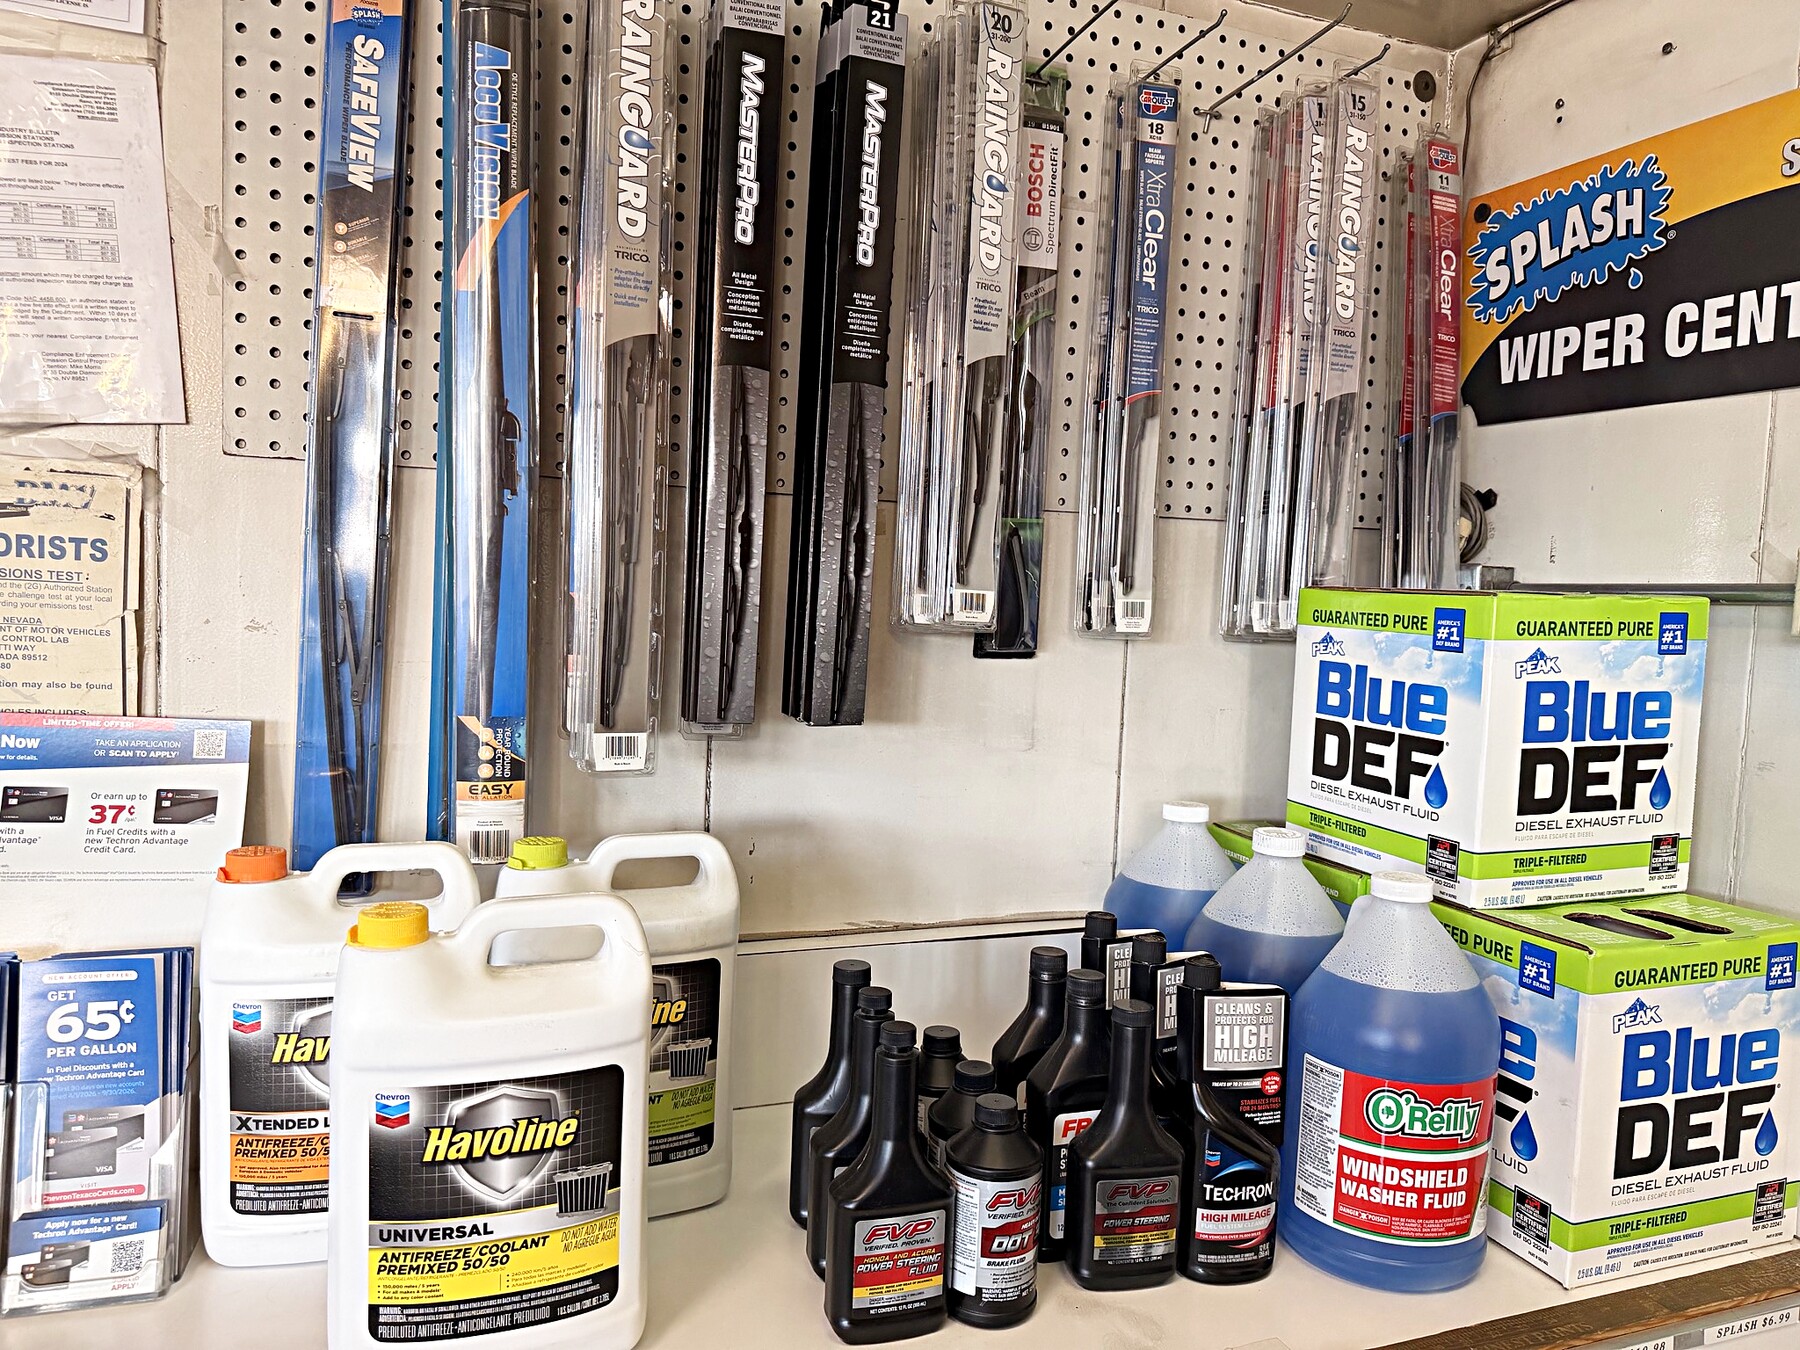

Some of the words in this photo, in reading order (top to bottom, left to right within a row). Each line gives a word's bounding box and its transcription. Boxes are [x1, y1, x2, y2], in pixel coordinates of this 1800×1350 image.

[354, 10, 381, 20] SPLASH
[870, 11, 892, 29] 21
[990, 12, 1012, 33] 20
[990, 32, 1012, 44] 31-200
[342, 42, 353, 105] PERFORMANCE
[1350, 94, 1366, 111] 15
[341, 107, 350, 134] WIPER
[348, 34, 385, 193] SAFEVIEW
[1350, 111, 1366, 121] 31-150
[1147, 122, 1165, 135] 18
[340, 136, 349, 163] BLADE
[735, 51, 766, 245] MASTERPRO
[978, 47, 1015, 271] RAINGUARD
[857, 80, 887, 267] MASTERPRO
[1027, 142, 1045, 218] BOSCH
[1049, 147, 1059, 197] DirectFit
[1438, 174, 1450, 185] 11
[1045, 200, 1055, 254] Spectrum
[1334, 125, 1368, 320] RAINGUARD
[1485, 188, 1644, 301] SPLASH
[614, 250, 650, 263] TRICO
[734, 278, 754, 286] Design
[976, 281, 1002, 293] TRICO
[728, 292, 760, 300] Conception
[1023, 284, 1046, 302] Beam
[849, 311, 878, 320] Conception
[1136, 305, 1159, 315] TRICO
[721, 327, 764, 336] completamente
[1333, 328, 1356, 338] TRICO
[1437, 333, 1456, 342] TRICO
[1499, 313, 1646, 384] WIPER
[44, 584, 84, 592] Authorized
[1313, 609, 1389, 628] GUARANTEED
[1393, 615, 1428, 631] PURE
[1517, 621, 1613, 637] GUARANTEED
[1617, 620, 1653, 636] PURE
[2, 635, 48, 643] CONTROL
[67, 628, 111, 637] VEHICLES
[1437, 626, 1460, 641] #1
[22, 681, 42, 689] may
[86, 682, 113, 690] found
[1316, 660, 1448, 735] Blue
[1523, 680, 1672, 743] Blue
[43, 718, 102, 727] LIMITED-TIME
[1, 734, 40, 749] Now
[95, 739, 116, 747] TAKE
[117, 739, 129, 747] AN
[130, 740, 181, 748] APPLICATION
[504, 727, 512, 749] YEAR
[495, 728, 503, 777] PROTECTION
[1312, 718, 1445, 800] DEF
[504, 750, 512, 778] ROUND
[469, 783, 514, 795] EASY
[1517, 743, 1669, 816] DEF
[1311, 780, 1346, 797] DIESEL
[1348, 790, 1401, 812] EXHAUST
[1403, 804, 1439, 822] FLUID
[88, 805, 135, 824] 37¢
[1515, 820, 1562, 832] DIESEL
[1566, 816, 1626, 829] EXHAUST
[1628, 813, 1663, 825] FLUID
[1310, 812, 1366, 838] TRIPLE-FILTERED
[143, 837, 189, 846] Advantage
[1514, 854, 1586, 869] TRIPLE-FILTERED
[1473, 936, 1514, 963] PURE
[1614, 961, 1719, 988] GUARANTEED
[1723, 956, 1761, 976] PURE
[47, 990, 76, 1001] GET
[1215, 1002, 1263, 1016] CLEANS
[1265, 1002, 1273, 1015] &
[46, 1000, 136, 1043] 65¢
[1215, 1016, 1257, 1025] PROTECTS
[1259, 1015, 1275, 1025] FOR
[1613, 1007, 1663, 1033] PEAK
[1215, 1025, 1273, 1049] HIGH
[47, 1047, 76, 1058] PER
[80, 1042, 137, 1056] GALLON
[1213, 1048, 1273, 1063] MILEAGE
[56, 1065, 71, 1073] Fuel
[73, 1063, 110, 1072] Discounts
[112, 1061, 128, 1069] with
[1620, 1028, 1780, 1102] Blue
[56, 1074, 85, 1082] Techron
[86, 1071, 126, 1081] Advantage
[127, 1069, 145, 1077] Card
[375, 1093, 410, 1101] Chevron
[235, 1116, 320, 1132] XTENDED
[1371, 1095, 1479, 1135] O'Reilly
[423, 1118, 578, 1162] Havoline
[1614, 1083, 1776, 1180] DEF
[95, 1165, 113, 1173] VISA
[1342, 1155, 1468, 1188] WINDSHIELD
[1611, 1180, 1662, 1198] DIESEL
[1666, 1170, 1729, 1190] EXHAUST
[1730, 1159, 1770, 1176] FLUID
[1107, 1180, 1170, 1200] FVP
[1203, 1182, 1273, 1202] TECHRON
[1340, 1177, 1418, 1209] WASHER
[1423, 1191, 1466, 1209] FLUID
[988, 1211, 1024, 1219] VERIFIED.
[1104, 1219, 1133, 1228] POWER
[1134, 1215, 1170, 1225] STEERING
[1201, 1213, 1228, 1222] HIGH
[1231, 1207, 1271, 1222] MILEAGE
[1609, 1210, 1688, 1235] TRIPLE-FILTERED
[378, 1222, 494, 1243] UNIVERSAL
[863, 1218, 936, 1244] FVP
[378, 1235, 550, 1264] ANTIFREEZE/COOLANT
[991, 1230, 1032, 1253] DOT
[376, 1262, 458, 1276] PREMIXED
[462, 1254, 511, 1271] 50/50
[857, 1261, 893, 1273] POWER
[897, 1253, 941, 1268] STEERING
[909, 1264, 938, 1276] FLUID
[1010, 1257, 1026, 1265] FLUID
[1716, 1320, 1758, 1339] SPLASH
[1761, 1312, 1791, 1328] $6.99
